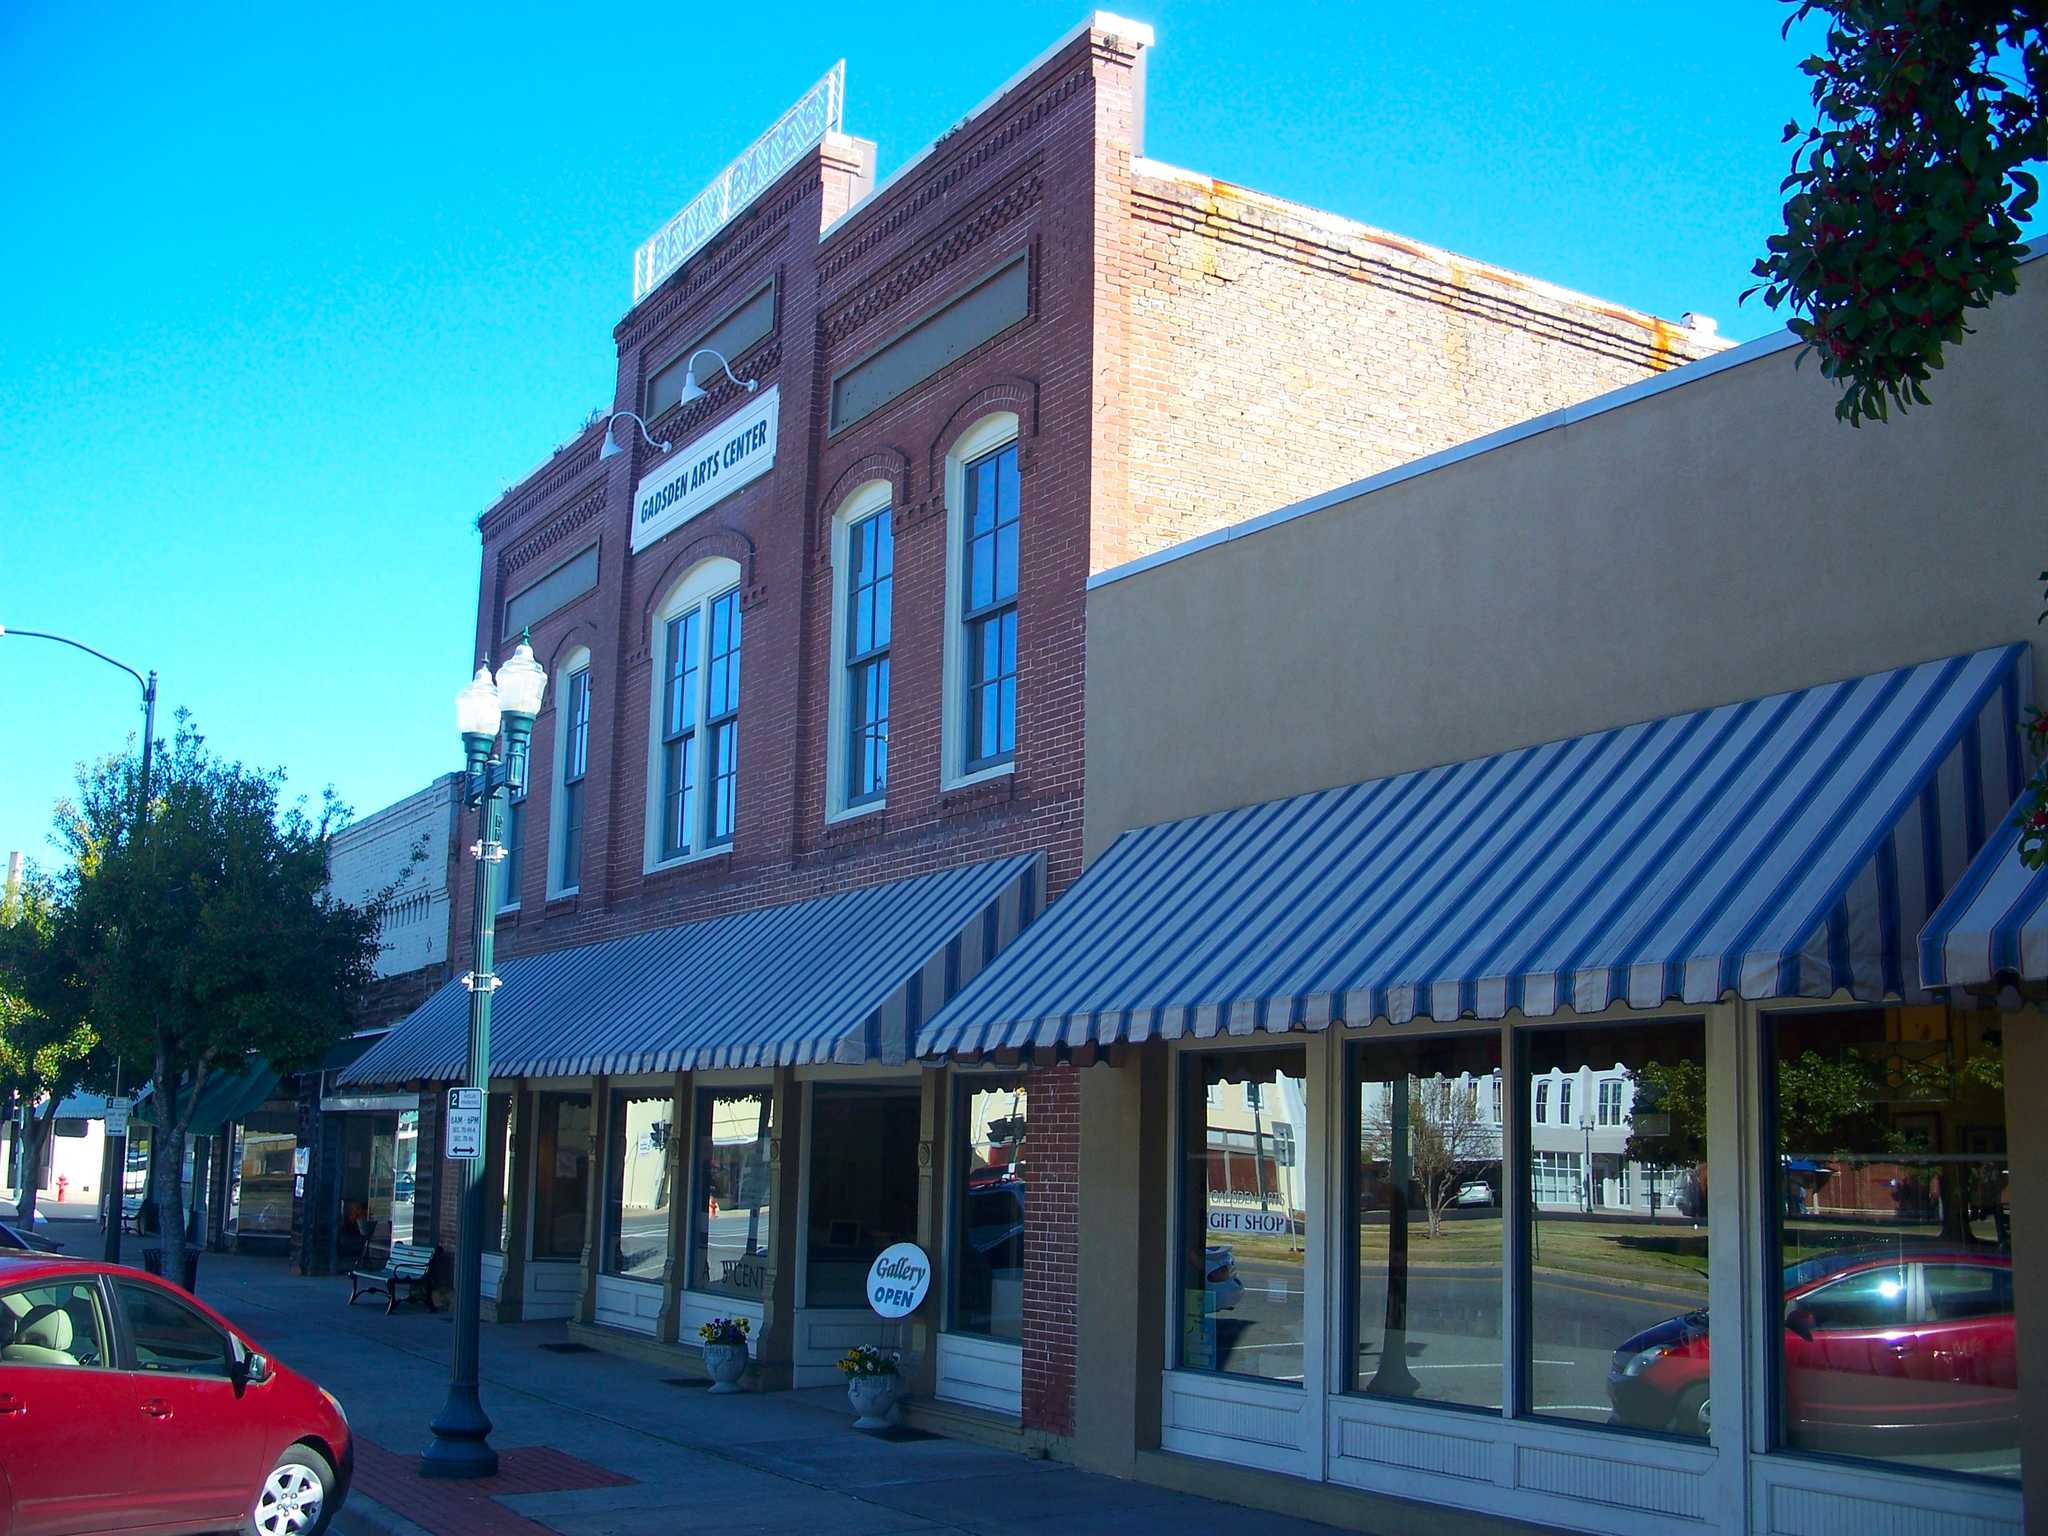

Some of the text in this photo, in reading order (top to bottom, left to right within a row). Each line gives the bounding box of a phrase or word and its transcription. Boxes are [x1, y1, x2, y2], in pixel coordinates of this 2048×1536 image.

[641, 419, 767, 524] GADSDEN ARTS CENTER
[451, 1093, 458, 1106] 2
[1262, 1191, 1285, 1206] ARTS
[1210, 1212, 1285, 1232] GIFT SHOP
[734, 1262, 767, 1288] CENT
[876, 1256, 926, 1290] Gallery
[874, 1286, 914, 1307] OPEN
